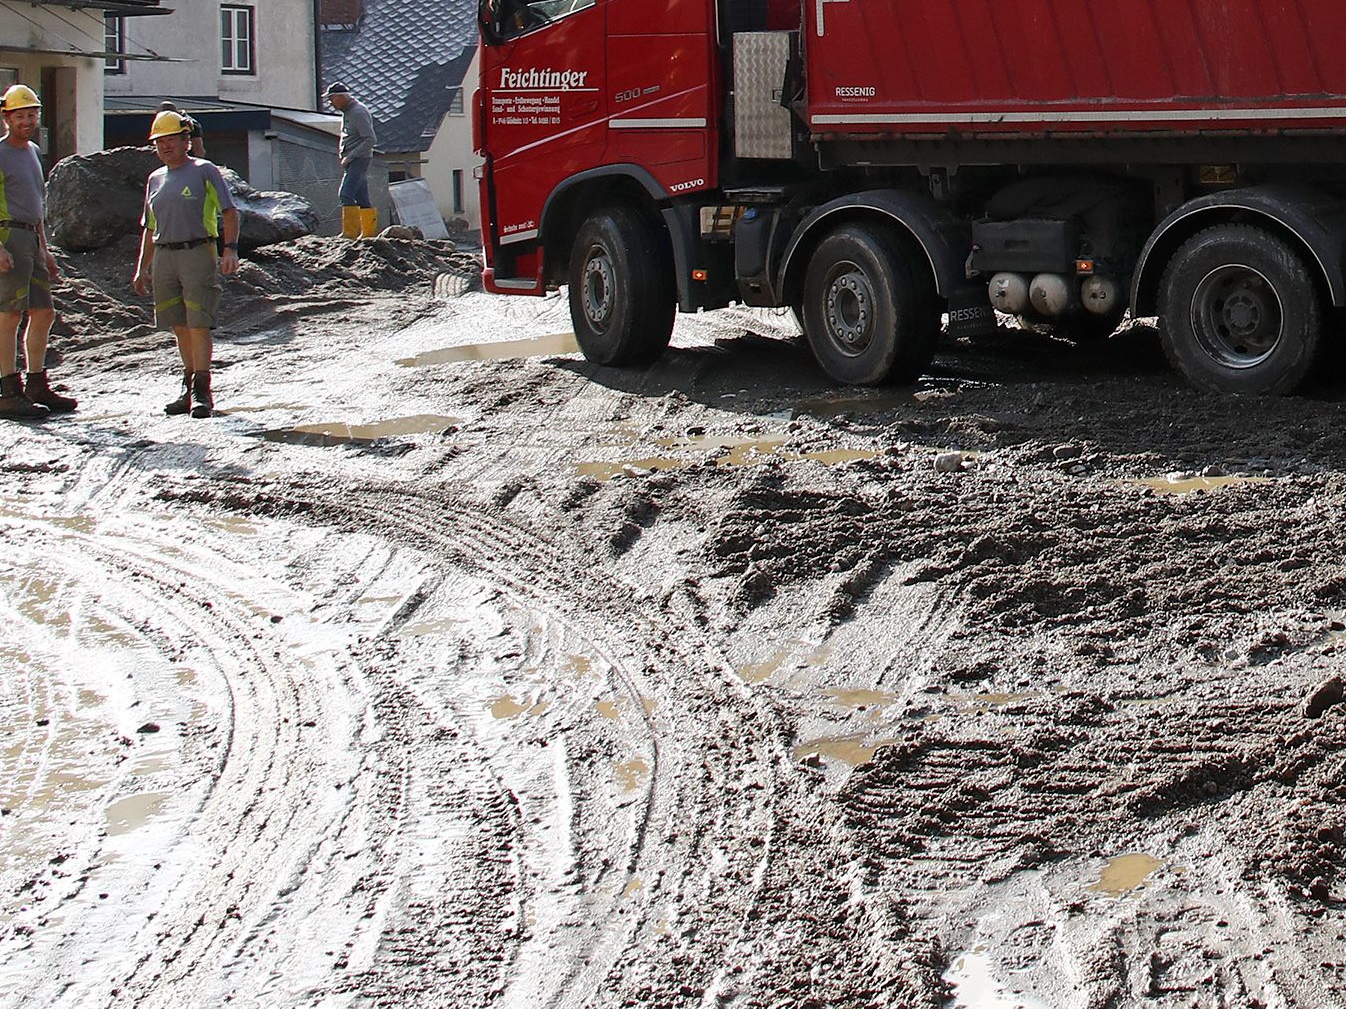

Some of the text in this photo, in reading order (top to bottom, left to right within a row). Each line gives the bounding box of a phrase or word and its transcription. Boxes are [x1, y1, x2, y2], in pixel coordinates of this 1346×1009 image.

[499, 67, 588, 91] Feichtinger
[615, 88, 640, 103] 500
[835, 87, 876, 97] RESSENIG
[670, 178, 705, 192] VOLVO
